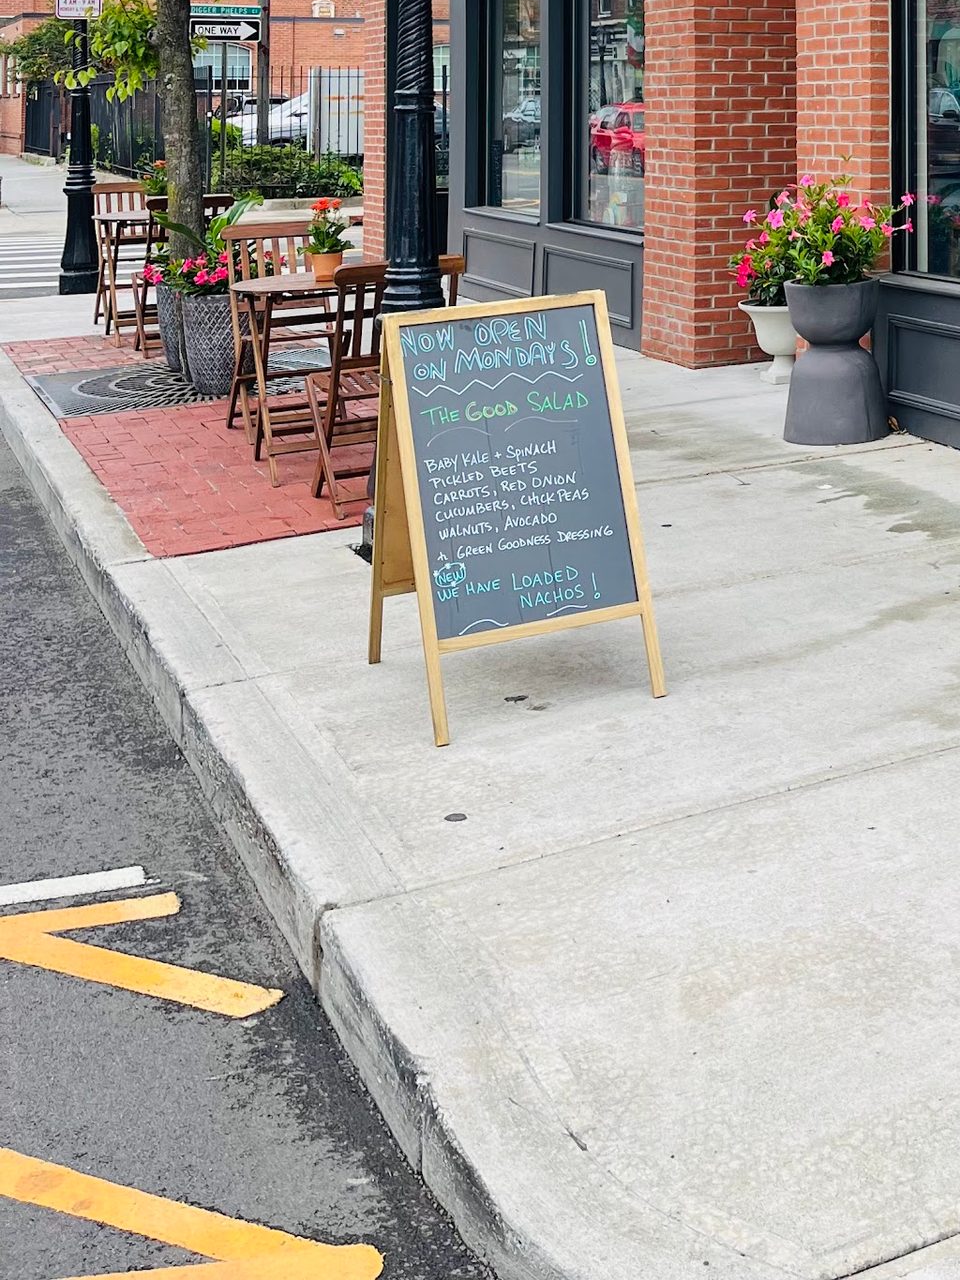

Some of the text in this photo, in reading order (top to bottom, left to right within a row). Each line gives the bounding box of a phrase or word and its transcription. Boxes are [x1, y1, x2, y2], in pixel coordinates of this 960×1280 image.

[197, 26, 240, 35] ONE WAY
[400, 313, 547, 357] NOW OPEN
[413, 358, 447, 381] ON
[419, 391, 588, 425] THE GOOD SALAD
[424, 455, 458, 473] BABY
[461, 450, 489, 467] KALE
[429, 461, 538, 490] PICKLED BEETS
[500, 479, 527, 493] RED
[504, 512, 558, 531] AVOCADO
[457, 543, 493, 560] GREEN
[498, 534, 551, 551] GOODNESS
[557, 525, 614, 543] DRESSING
[437, 565, 579, 602] WE HAVE LOADED
[438, 569, 465, 585] NEW
